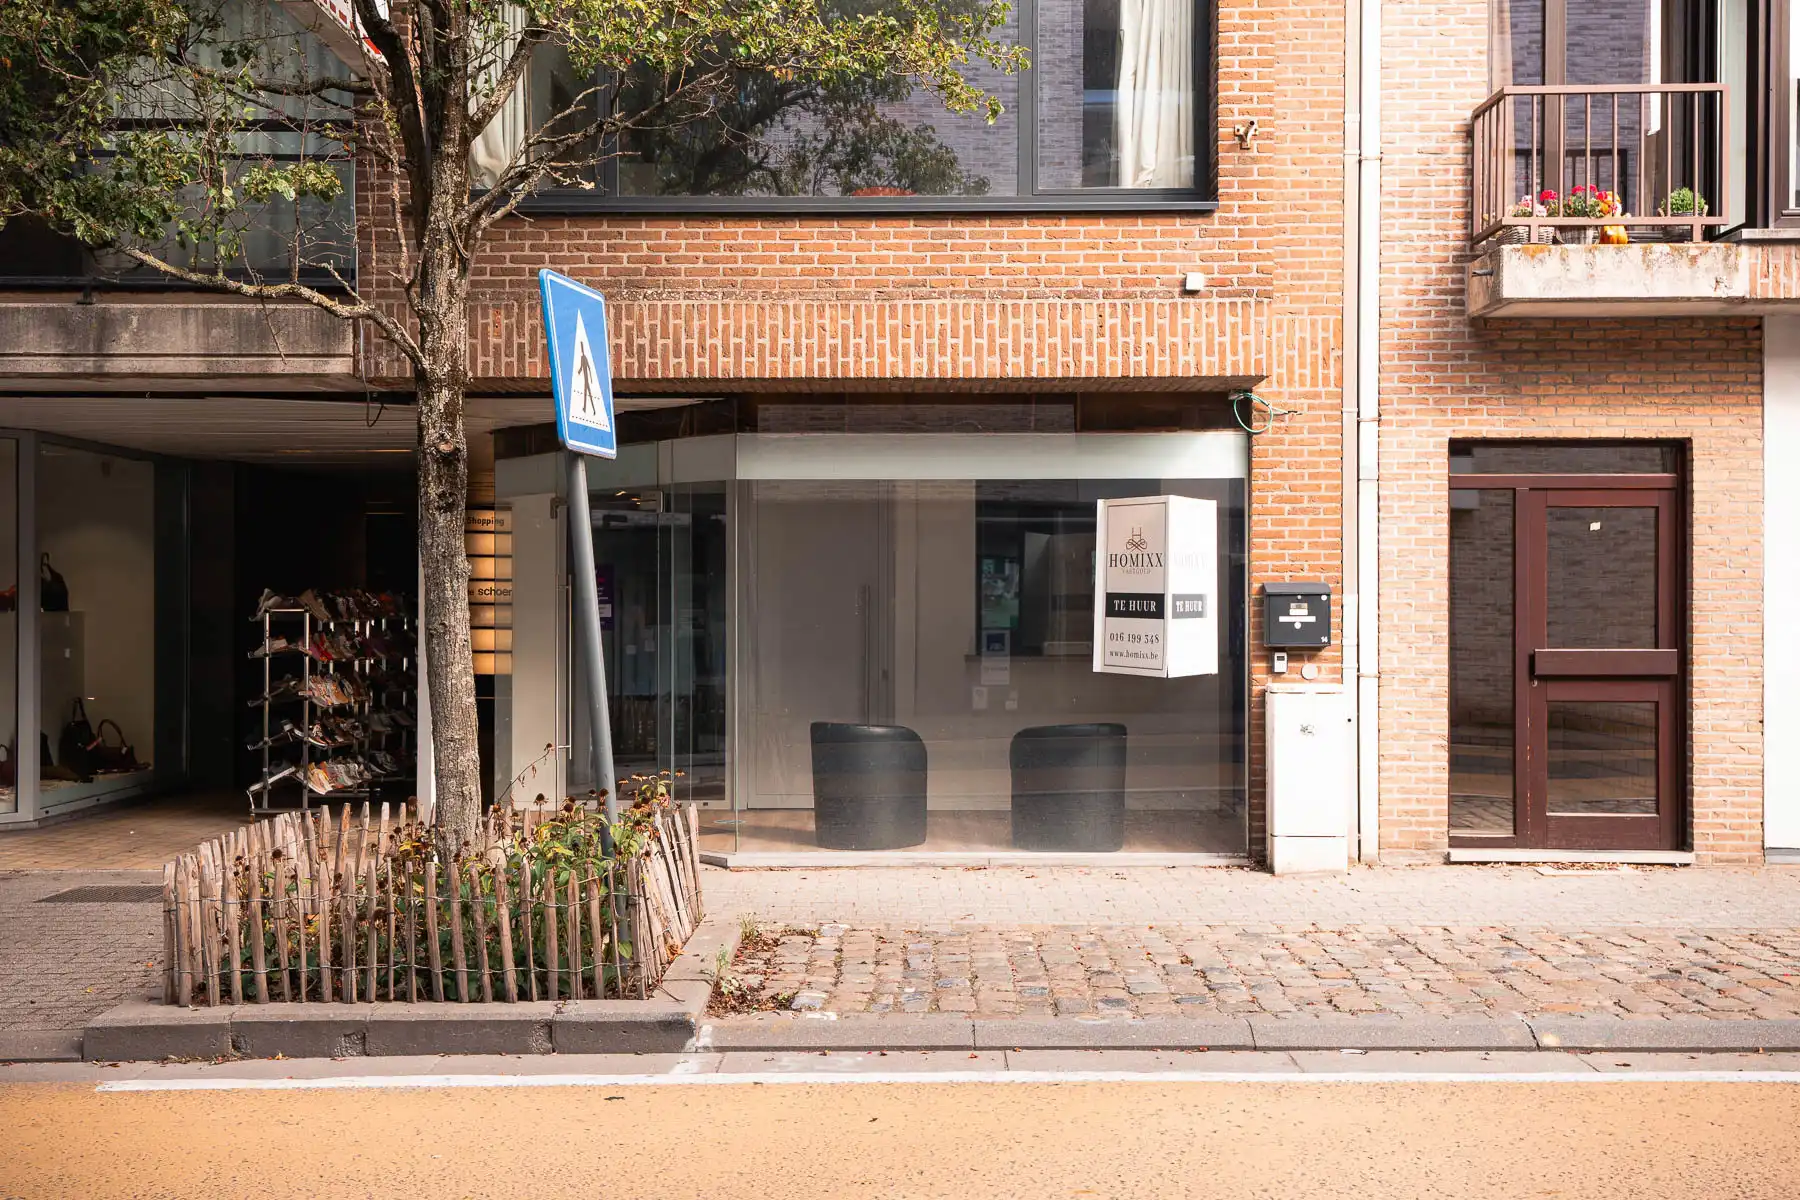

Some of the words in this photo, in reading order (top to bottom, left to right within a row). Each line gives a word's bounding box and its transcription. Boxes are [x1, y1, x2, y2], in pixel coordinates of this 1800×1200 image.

[467, 516, 504, 526] Shopping
[1109, 553, 1163, 567] HOMIXX
[1114, 600, 1126, 611] TE
[1129, 600, 1156, 612] HUUR
[1176, 600, 1183, 612] TE
[1185, 600, 1203, 612] HUUR
[1109, 632, 1124, 642] 016
[1128, 633, 1141, 644] 199
[1109, 649, 1159, 660] www.homixx.be
